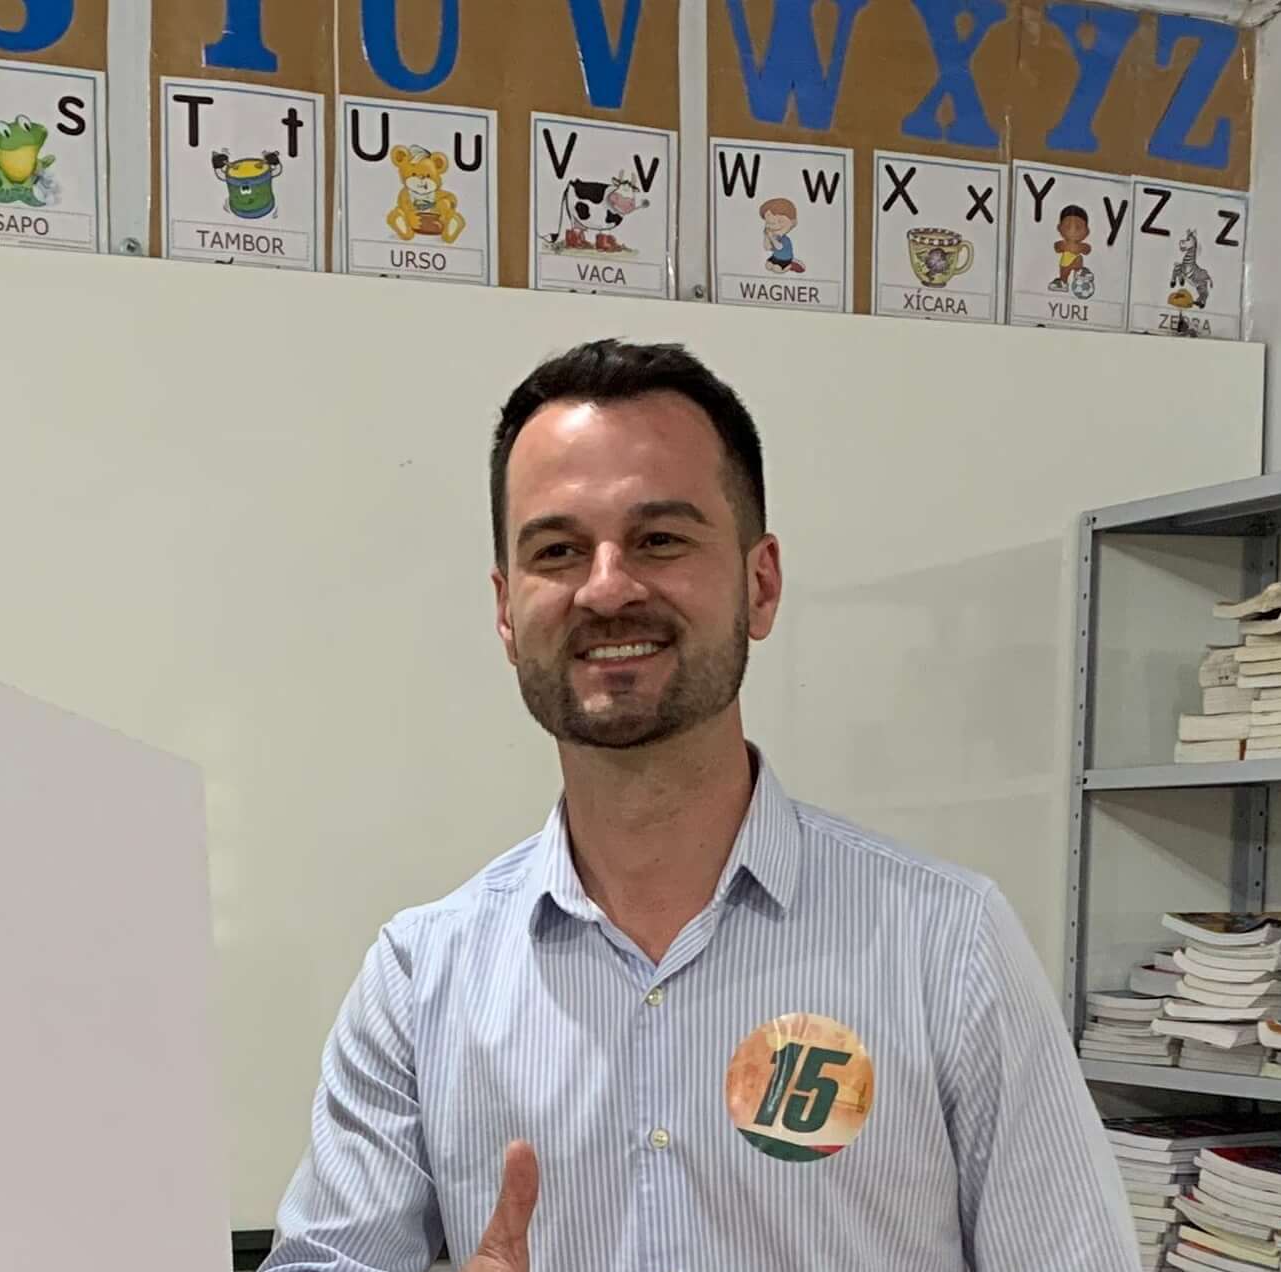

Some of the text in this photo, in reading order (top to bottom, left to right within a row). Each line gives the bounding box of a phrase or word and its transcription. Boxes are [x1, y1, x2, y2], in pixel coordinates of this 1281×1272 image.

[570, 0, 642, 110] V
[727, 0, 866, 133] W
[901, 0, 1006, 149] X
[1043, 5, 1140, 153] Y
[1147, 8, 1239, 170] Z
[57, 96, 86, 136] s
[172, 94, 304, 158] T t
[351, 109, 390, 163] U
[542, 128, 577, 180] V
[719, 151, 760, 199] W
[883, 164, 919, 216] X
[1023, 173, 1129, 247] Y y
[1141, 188, 1171, 237] Z
[196, 229, 286, 257] TAMBOR
[390, 249, 447, 273] URSO
[576, 263, 627, 286] VACA
[739, 281, 820, 305] WAGNER
[903, 289, 968, 316] XÍCARA
[1047, 301, 1089, 323] YURI
[753, 1042, 853, 1133] 15
